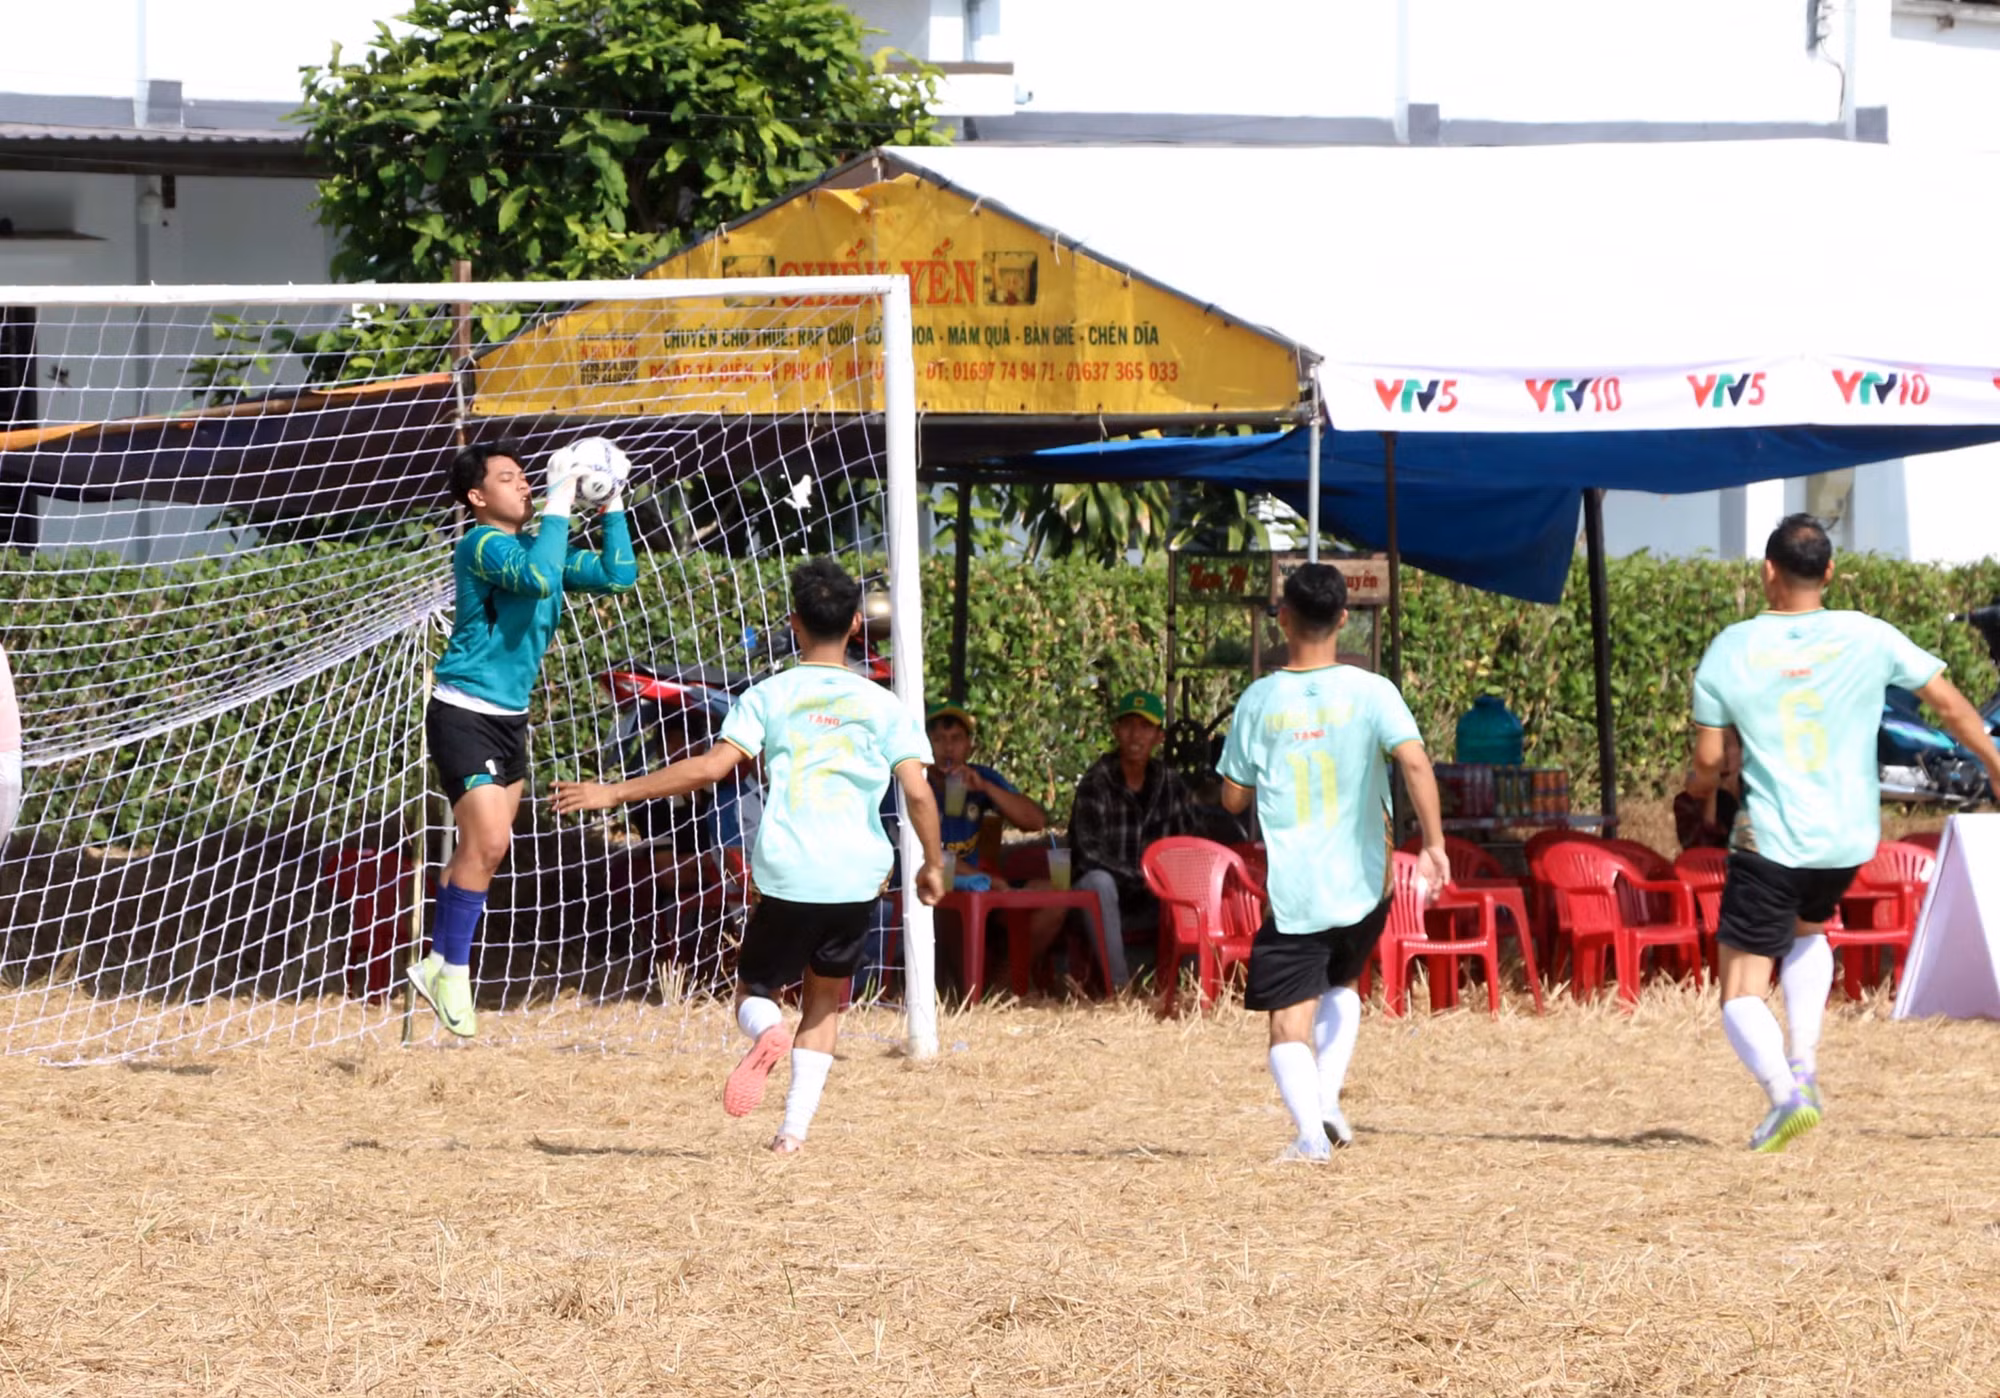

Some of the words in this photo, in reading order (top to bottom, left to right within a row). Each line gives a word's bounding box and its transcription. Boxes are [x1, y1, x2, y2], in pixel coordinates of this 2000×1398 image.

[663, 323, 718, 349] CHUYÊN
[721, 328, 750, 348] CHO
[797, 327, 824, 350] RẠP
[1088, 319, 1128, 346] CHÉN
[952, 360, 996, 382] 01697
[1000, 360, 1017, 382] 74
[1020, 360, 1037, 382] 94
[1040, 360, 1056, 382] 71
[1065, 360, 1110, 382] 01637
[1115, 360, 1144, 382] 365
[1149, 360, 1179, 382] 033
[1778, 688, 1827, 772] 6
[1285, 750, 1339, 832] 11
